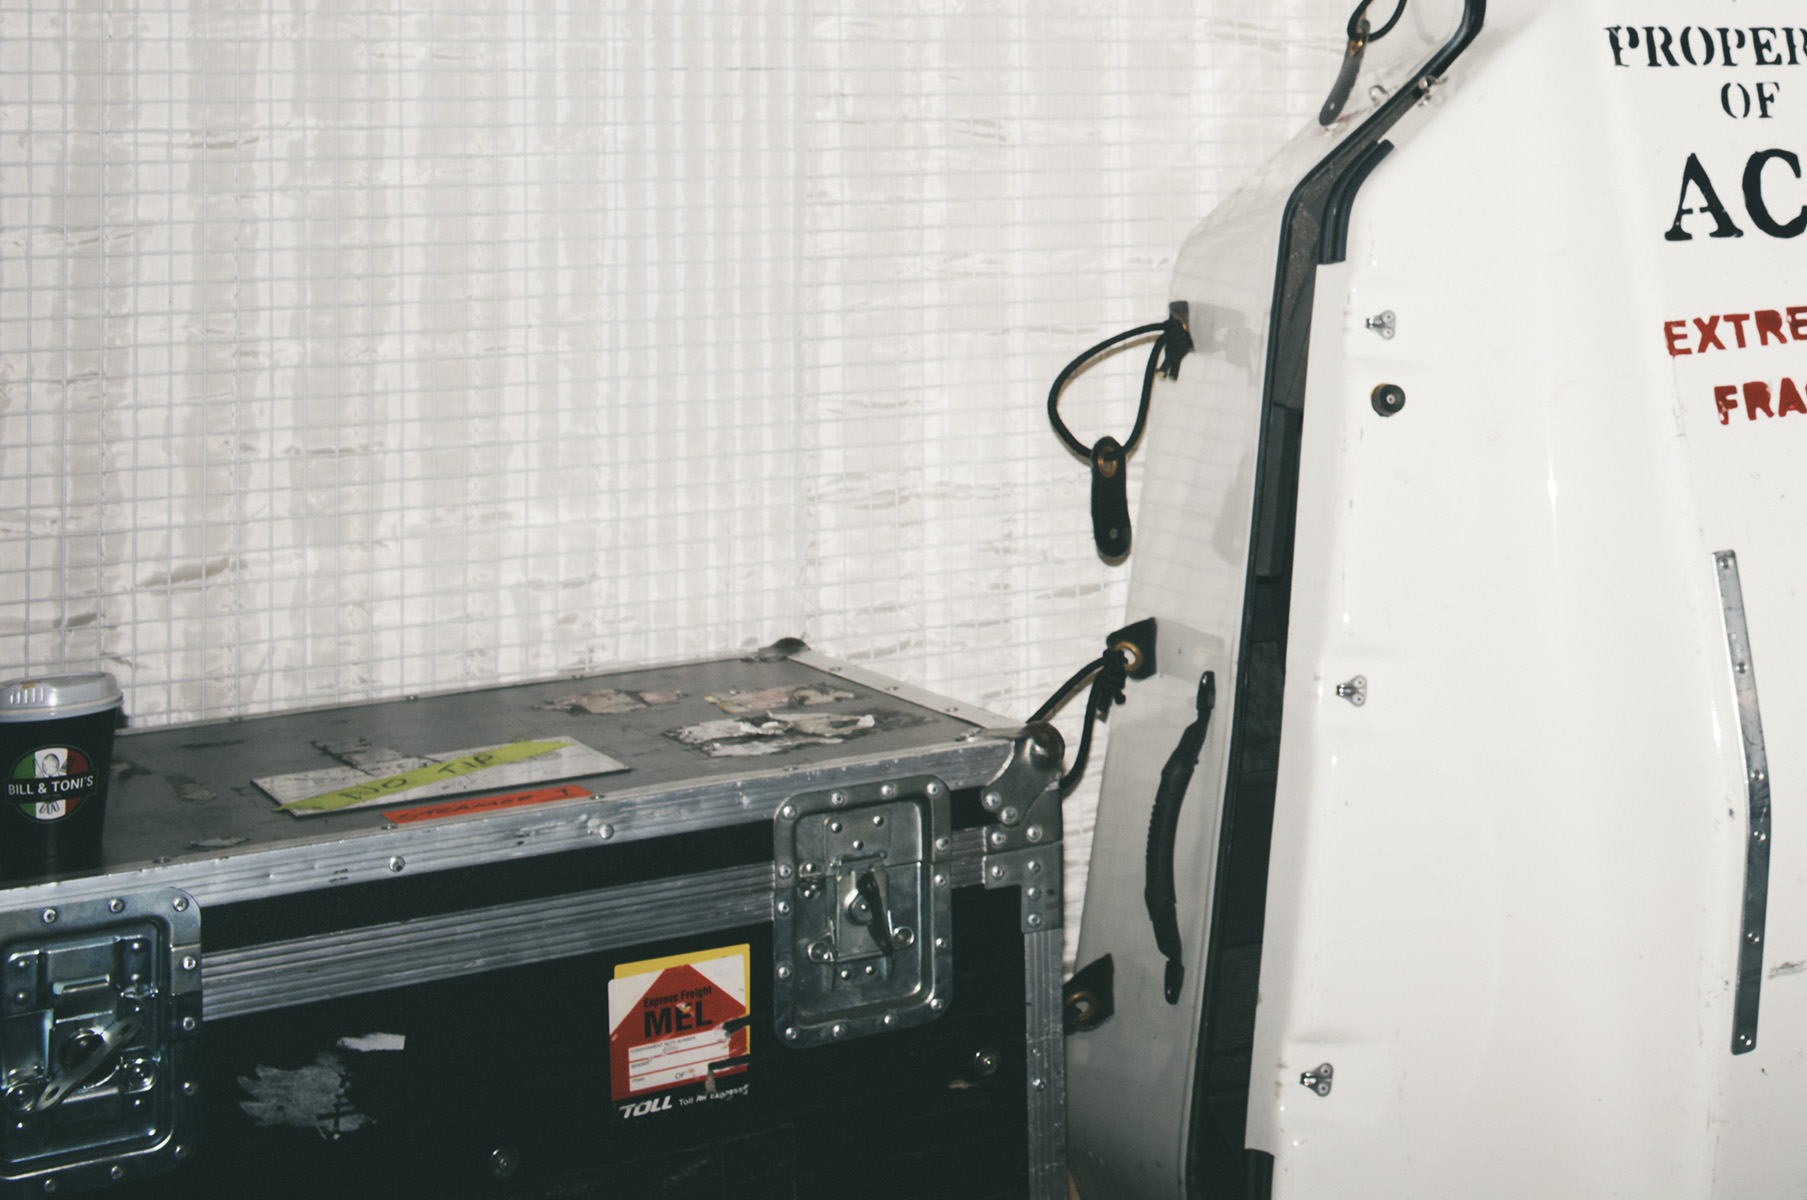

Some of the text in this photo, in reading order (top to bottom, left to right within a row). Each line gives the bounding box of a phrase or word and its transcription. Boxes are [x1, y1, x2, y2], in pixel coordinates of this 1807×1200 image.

[1720, 81, 1780, 119] OF
[438, 754, 494, 774] TIP
[8, 775, 94, 795] BILL & TONI'S
[643, 985, 712, 1008] Express Freight
[644, 1001, 713, 1039] MEL
[619, 1095, 673, 1119] TOLL
[679, 1096, 694, 1106] Toll
